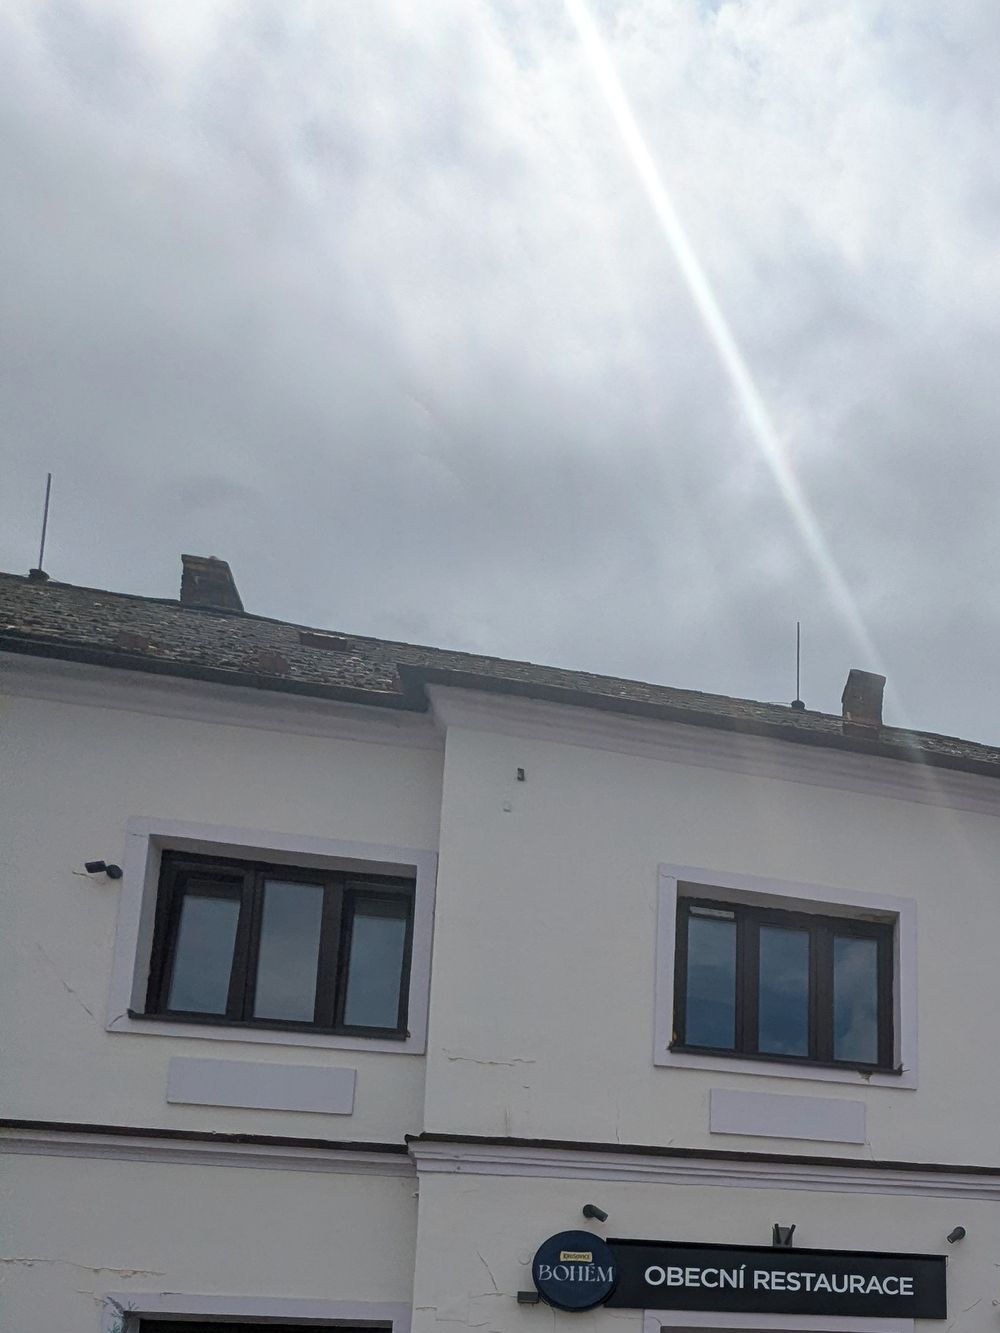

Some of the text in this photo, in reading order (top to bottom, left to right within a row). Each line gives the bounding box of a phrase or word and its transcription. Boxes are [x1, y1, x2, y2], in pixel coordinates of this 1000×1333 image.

[538, 1263, 614, 1282] BOHÉM
[644, 1264, 915, 1296] OBECNÍ RESTAURACE
